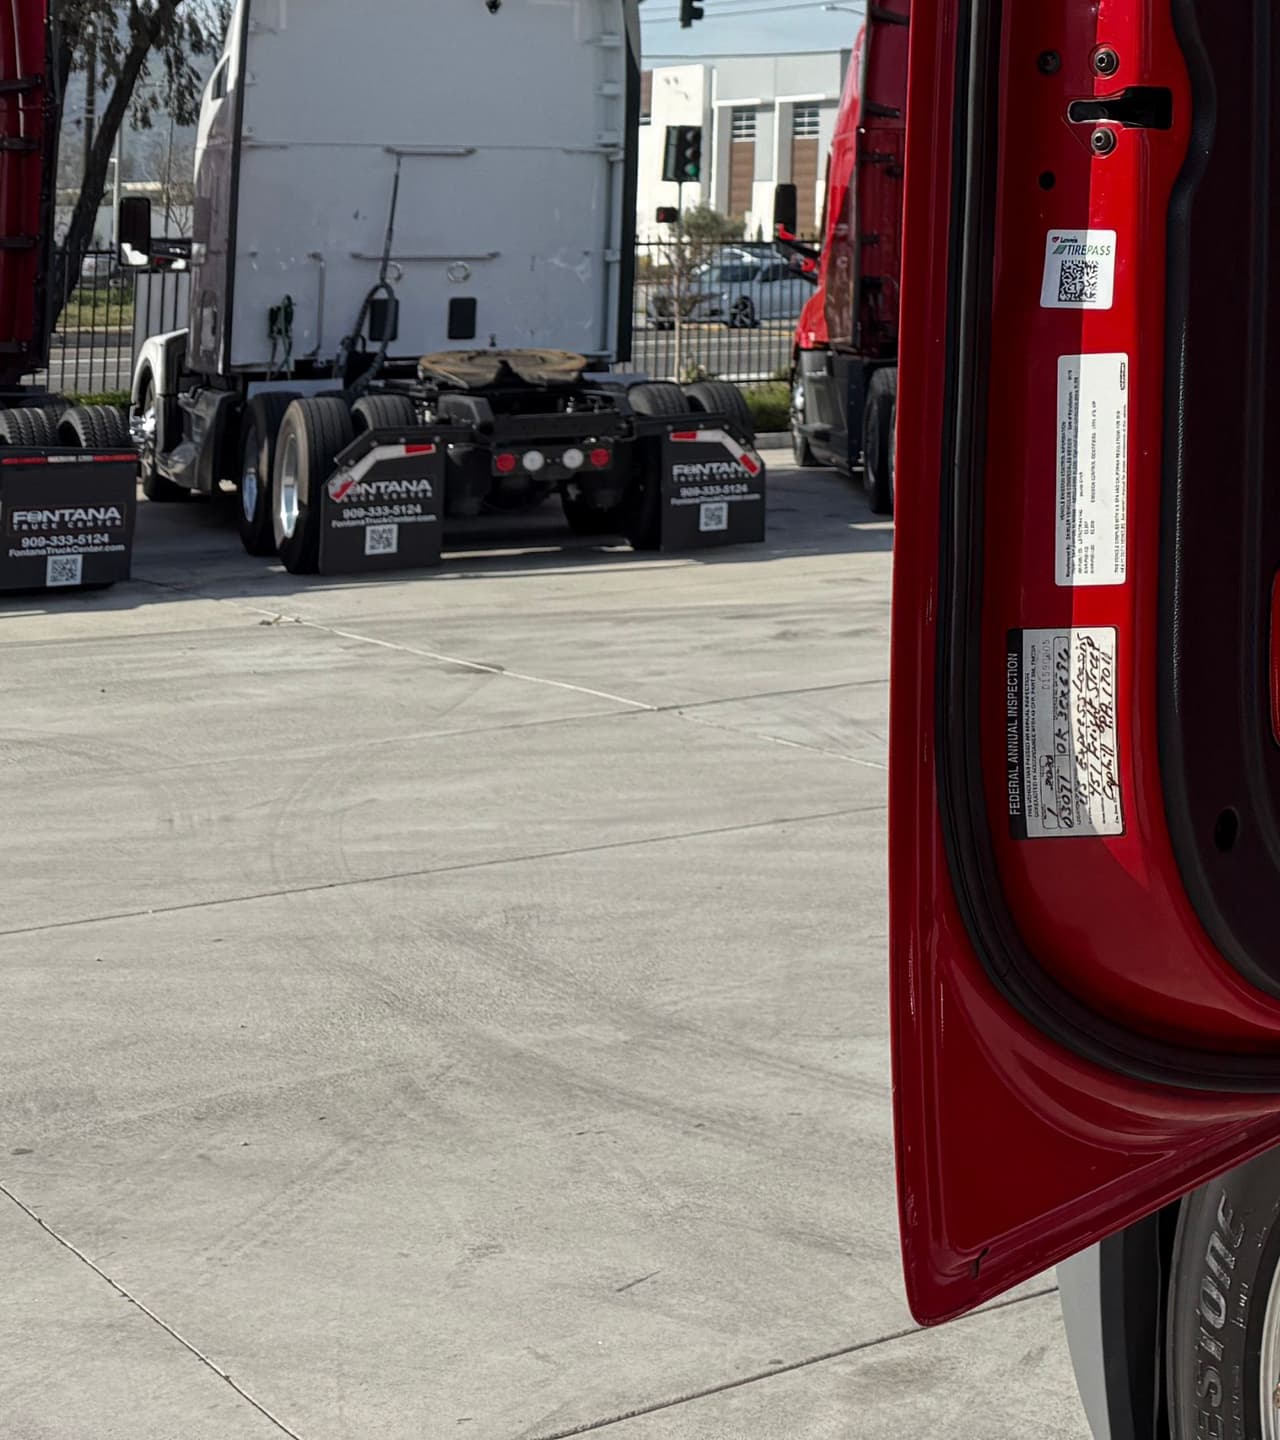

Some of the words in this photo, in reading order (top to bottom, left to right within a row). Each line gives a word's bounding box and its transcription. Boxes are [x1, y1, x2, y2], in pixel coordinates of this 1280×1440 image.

[1067, 244, 1111, 256] TIREPASS
[672, 461, 744, 475] FONTAN
[680, 483, 749, 497] 909-333-5124
[12, 506, 122, 524] FONTANA
[343, 504, 422, 519] 909-333-5124
[13, 522, 58, 531] TRUCK
[67, 520, 122, 529] CENTER
[21, 533, 110, 548] 909-333-5124
[8, 544, 125, 557] FontanaTruckCenter.com
[1007, 653, 1019, 717] INSPECTION
[1007, 720, 1020, 763] ANNUAL
[1008, 766, 1021, 815] FEDERAL
